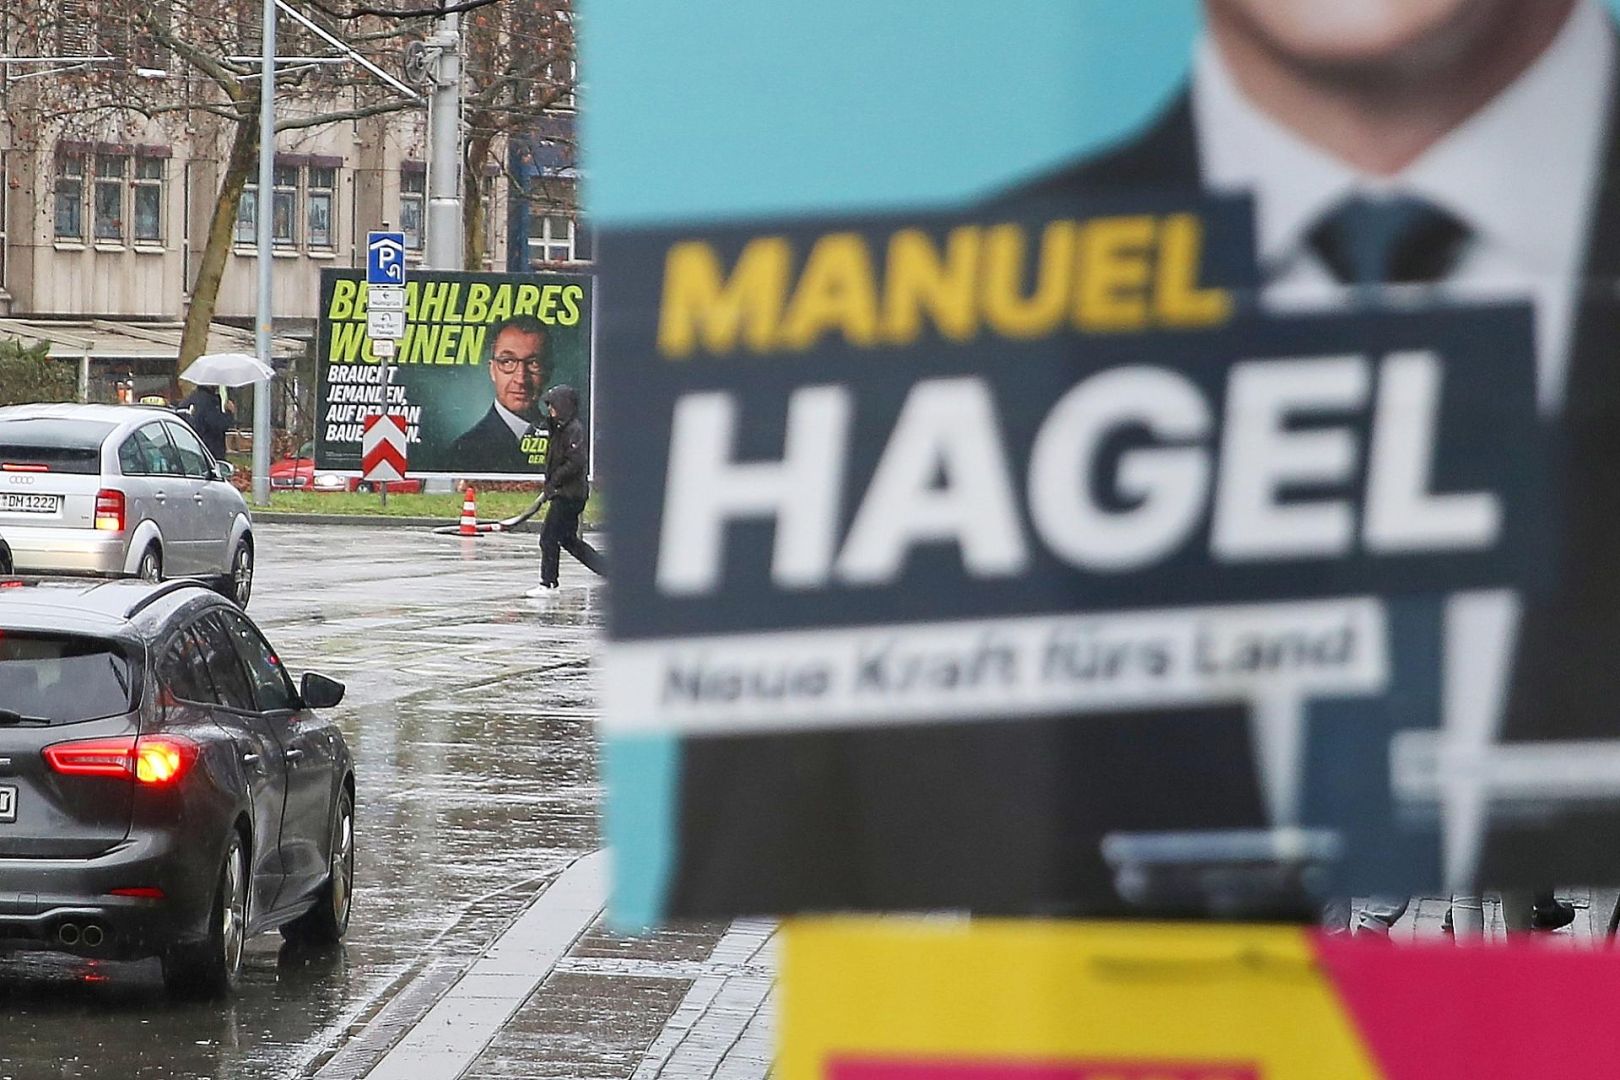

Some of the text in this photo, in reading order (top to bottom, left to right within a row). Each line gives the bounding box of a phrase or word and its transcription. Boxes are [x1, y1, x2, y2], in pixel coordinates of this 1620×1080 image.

[379, 247, 395, 269] P
[657, 211, 1233, 360] MANUEL
[328, 279, 584, 326] BEAHLBARES
[325, 404, 357, 422] AUF
[325, 424, 365, 442] BAUE
[521, 434, 549, 453] ÖZD
[656, 349, 1504, 595] HAGEL
[9, 495, 55, 509] DM 1222
[660, 604, 1355, 708] Neue Kraft fürs Land
